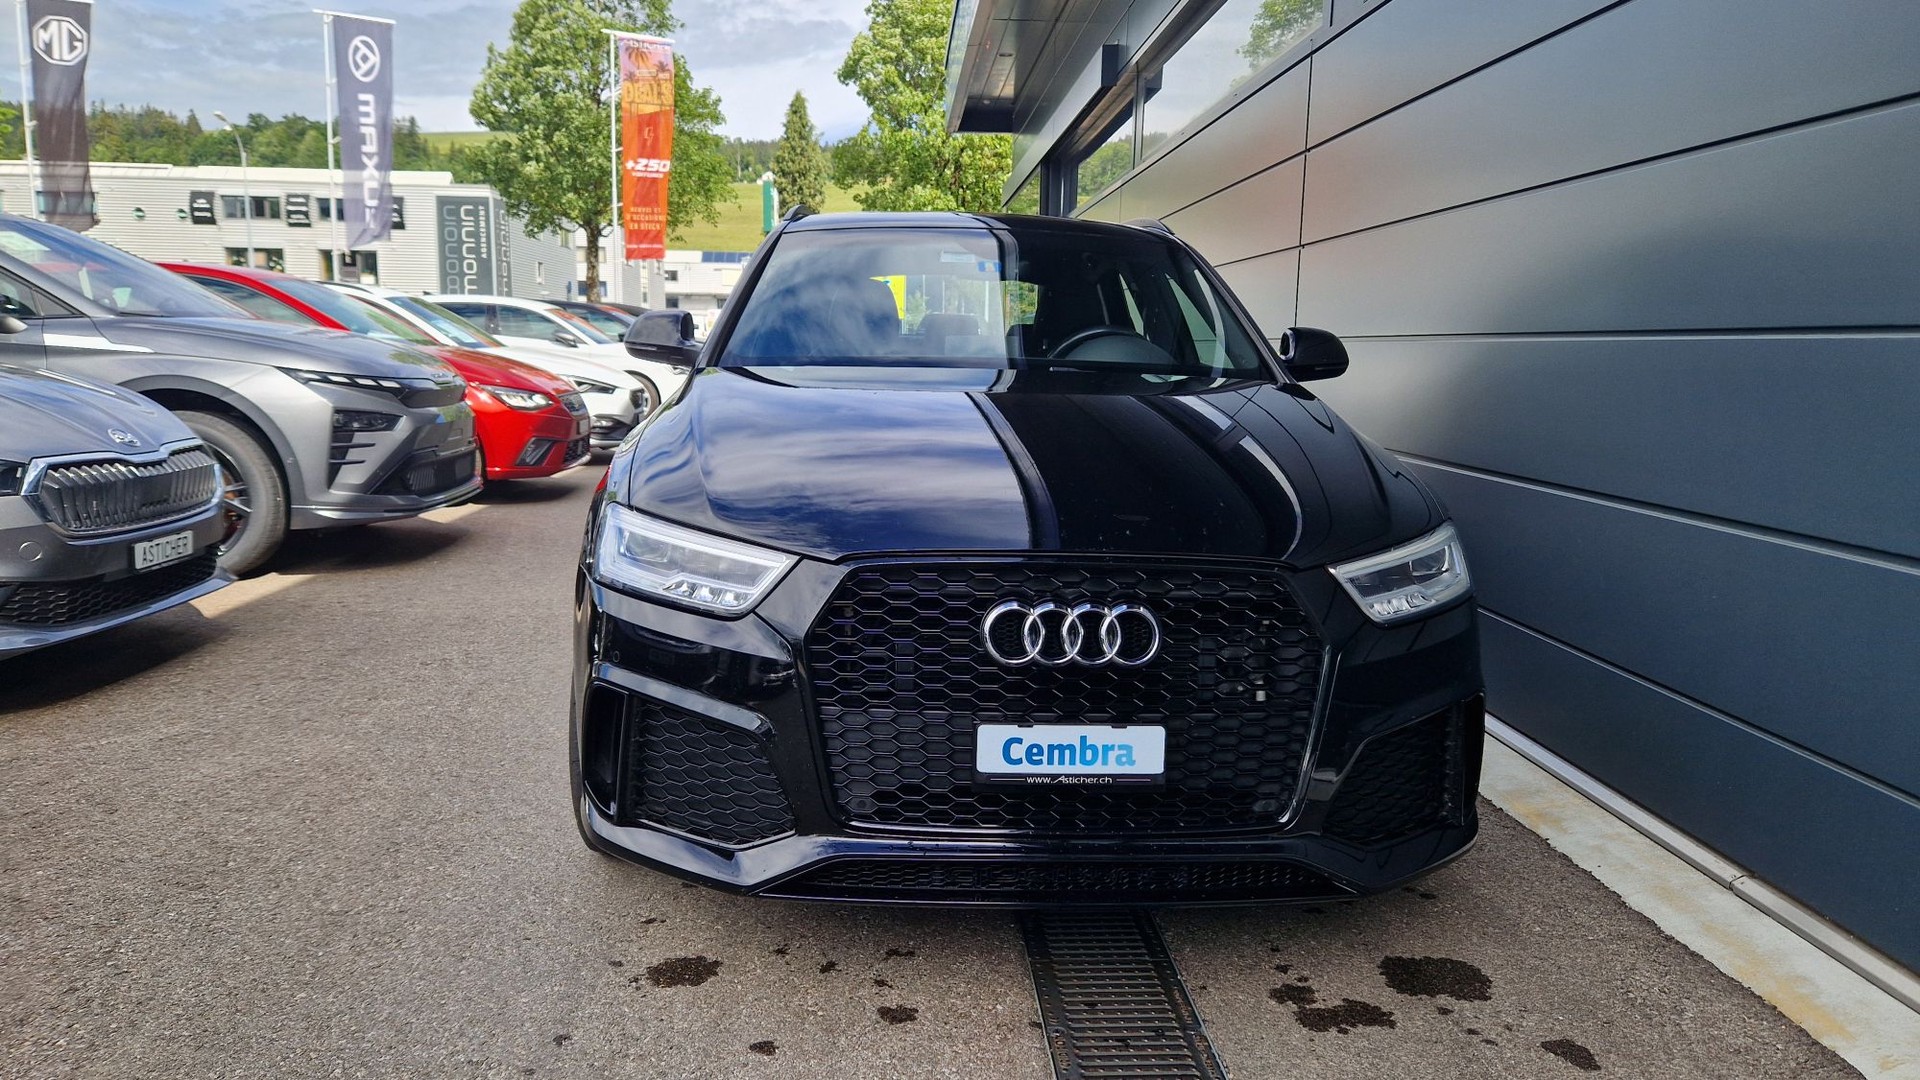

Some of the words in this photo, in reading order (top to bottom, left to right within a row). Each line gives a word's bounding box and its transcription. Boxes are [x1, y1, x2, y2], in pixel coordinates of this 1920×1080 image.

[37, 20, 84, 60] MG
[625, 158, 670, 172] +250
[141, 536, 189, 566] ASTICHER
[1001, 735, 1137, 767] Cembra
[1026, 774, 1113, 785] www.Asticher.ch
